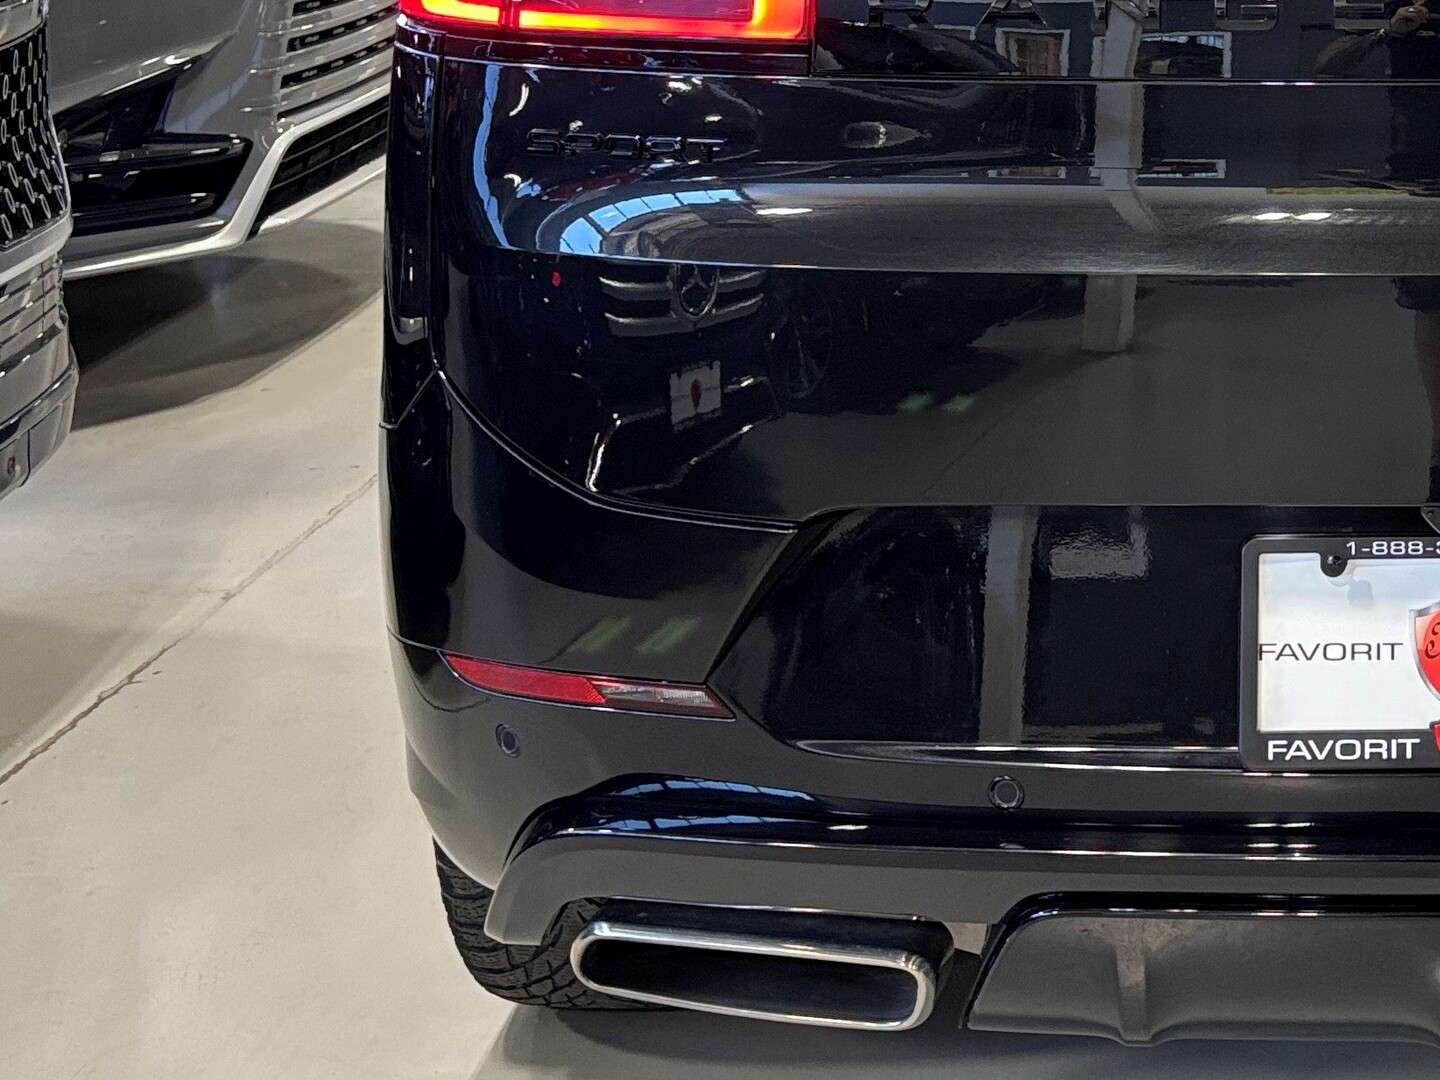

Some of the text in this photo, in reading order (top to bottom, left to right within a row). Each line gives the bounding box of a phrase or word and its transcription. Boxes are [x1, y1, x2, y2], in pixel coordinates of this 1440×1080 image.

[525, 126, 729, 163] SPORT
[1258, 641, 1404, 662] FAVORIT
[1267, 737, 1421, 762] FAVORIT
